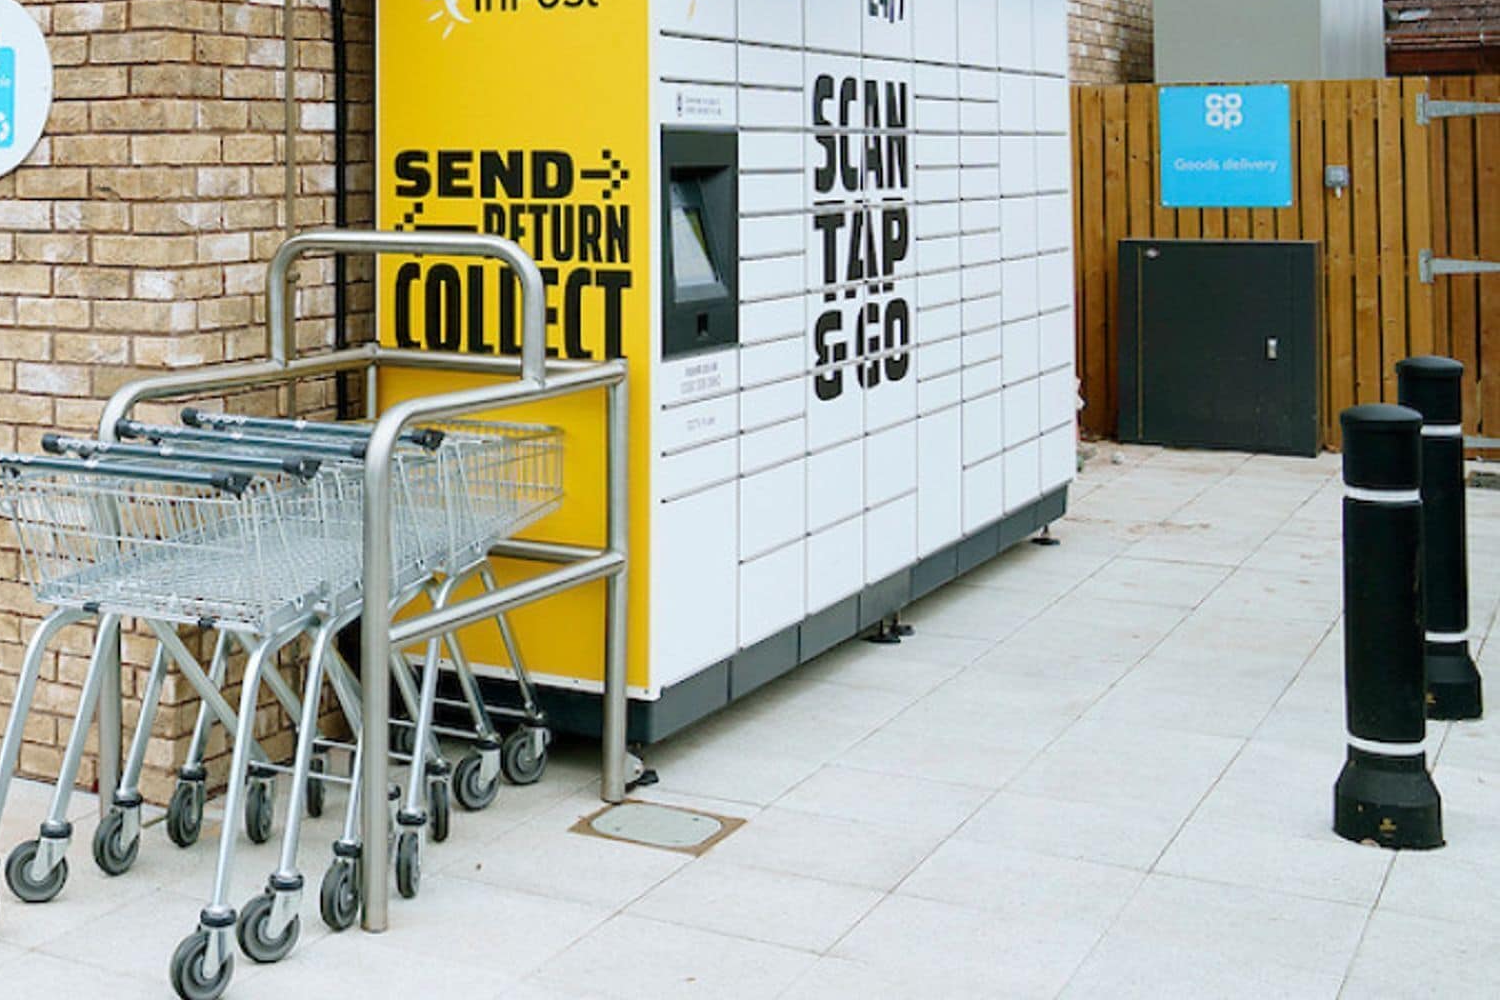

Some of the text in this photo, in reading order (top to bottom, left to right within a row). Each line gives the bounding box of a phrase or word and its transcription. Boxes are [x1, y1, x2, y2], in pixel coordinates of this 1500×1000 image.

[812, 74, 908, 194] SCAN
[1174, 157, 1278, 173] Goods delivery
[394, 149, 574, 199] SEND
[484, 203, 630, 264] RETURN
[813, 197, 908, 303] TAP
[855, 297, 910, 390] GO
